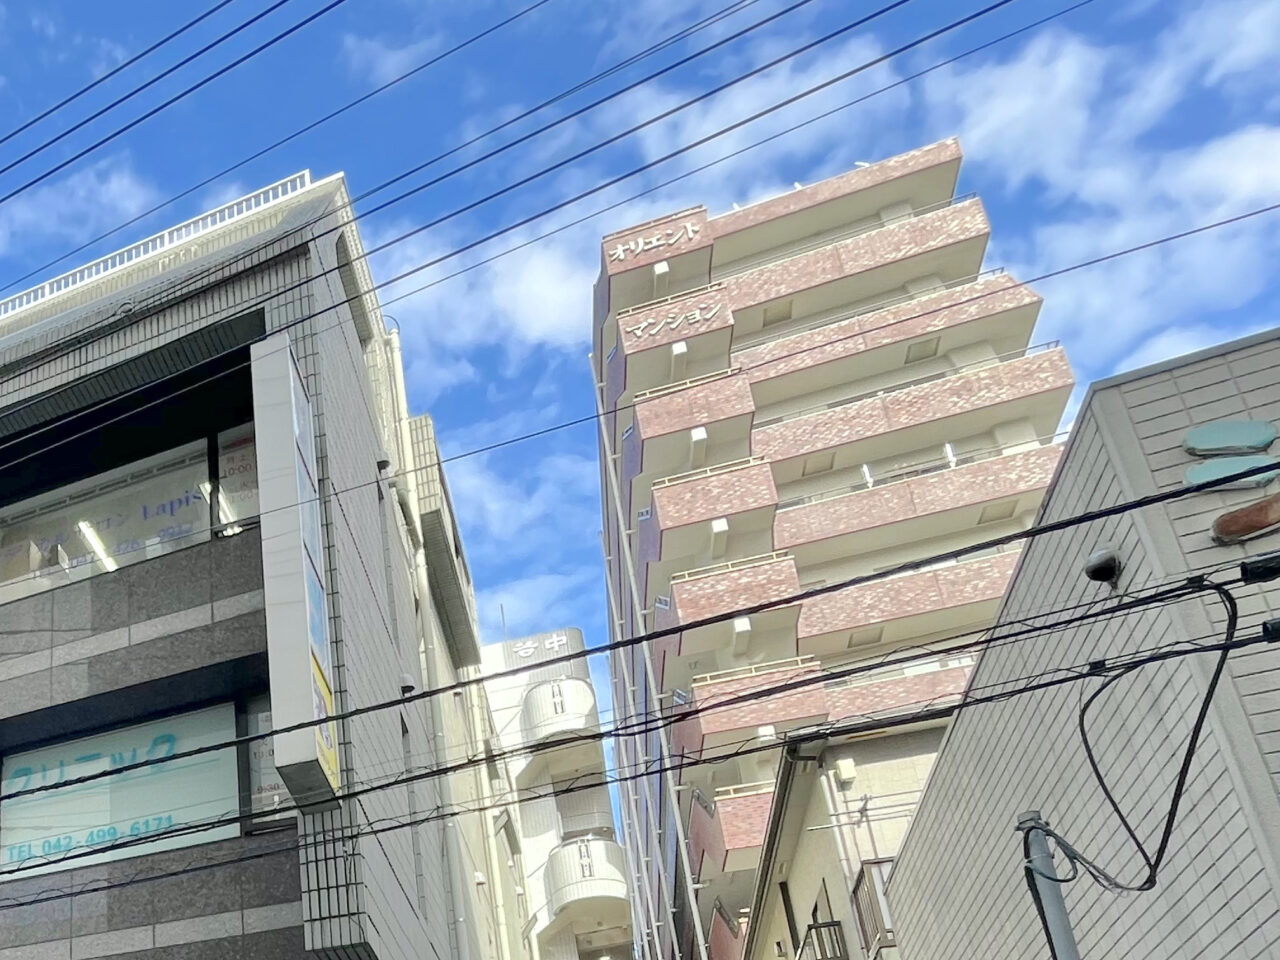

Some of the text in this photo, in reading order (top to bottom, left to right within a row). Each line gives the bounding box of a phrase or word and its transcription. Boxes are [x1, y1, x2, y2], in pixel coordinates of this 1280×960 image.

[609, 222, 700, 263] オリエント
[625, 303, 721, 338] マンション
[7, 844, 35, 862] TEL
